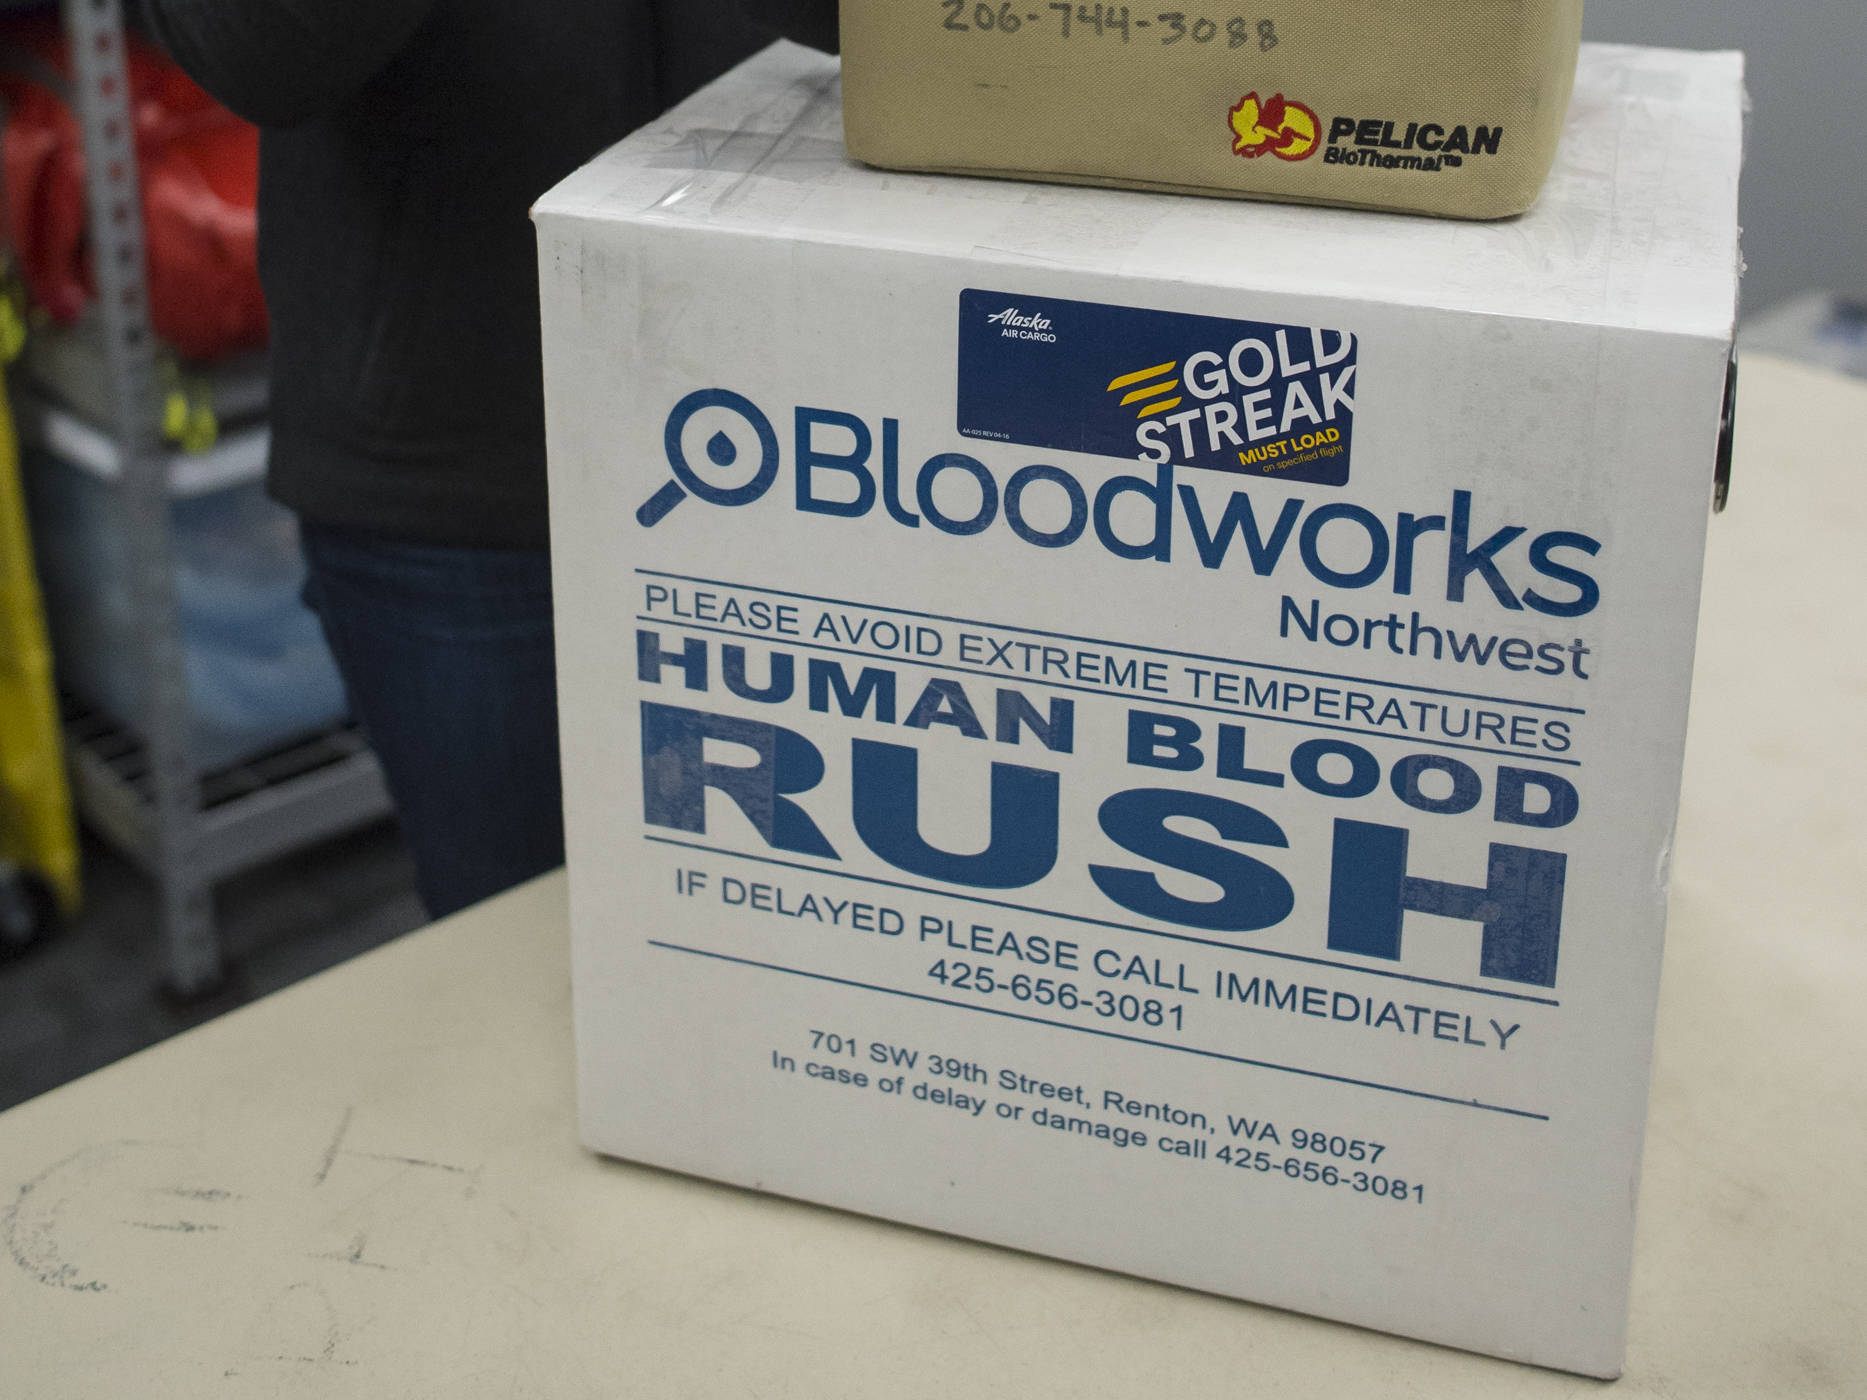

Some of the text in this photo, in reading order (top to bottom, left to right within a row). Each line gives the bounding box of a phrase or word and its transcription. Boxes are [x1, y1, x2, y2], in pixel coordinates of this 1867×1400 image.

[1328, 117, 1503, 154] PELICAN
[987, 308, 1052, 331] Alaska
[1001, 328, 1056, 342] AIR CARGO
[1183, 327, 1352, 400] GOLD
[1135, 365, 1356, 465] STREAK
[1238, 427, 1340, 466] MUST LOAD
[1262, 444, 1344, 473] on specified flight
[793, 405, 1601, 618] Bloodworks
[645, 584, 1571, 752] PLEASE AVOID EXTREME TEMPERATURES
[1280, 595, 1590, 680] Northwest
[636, 628, 1580, 829] HUMAN BLOOD
[640, 700, 1568, 988] RUSH
[676, 868, 1521, 1050] IF DELAYED PLEASE CALL IMMEDIATELY
[928, 959, 1184, 1031] 425-656-3081
[772, 1050, 1425, 1204] In case of delay or damage call 425-656-3081
[809, 1029, 1386, 1164] 701 SW 39th Street, Renton, WA 98057
